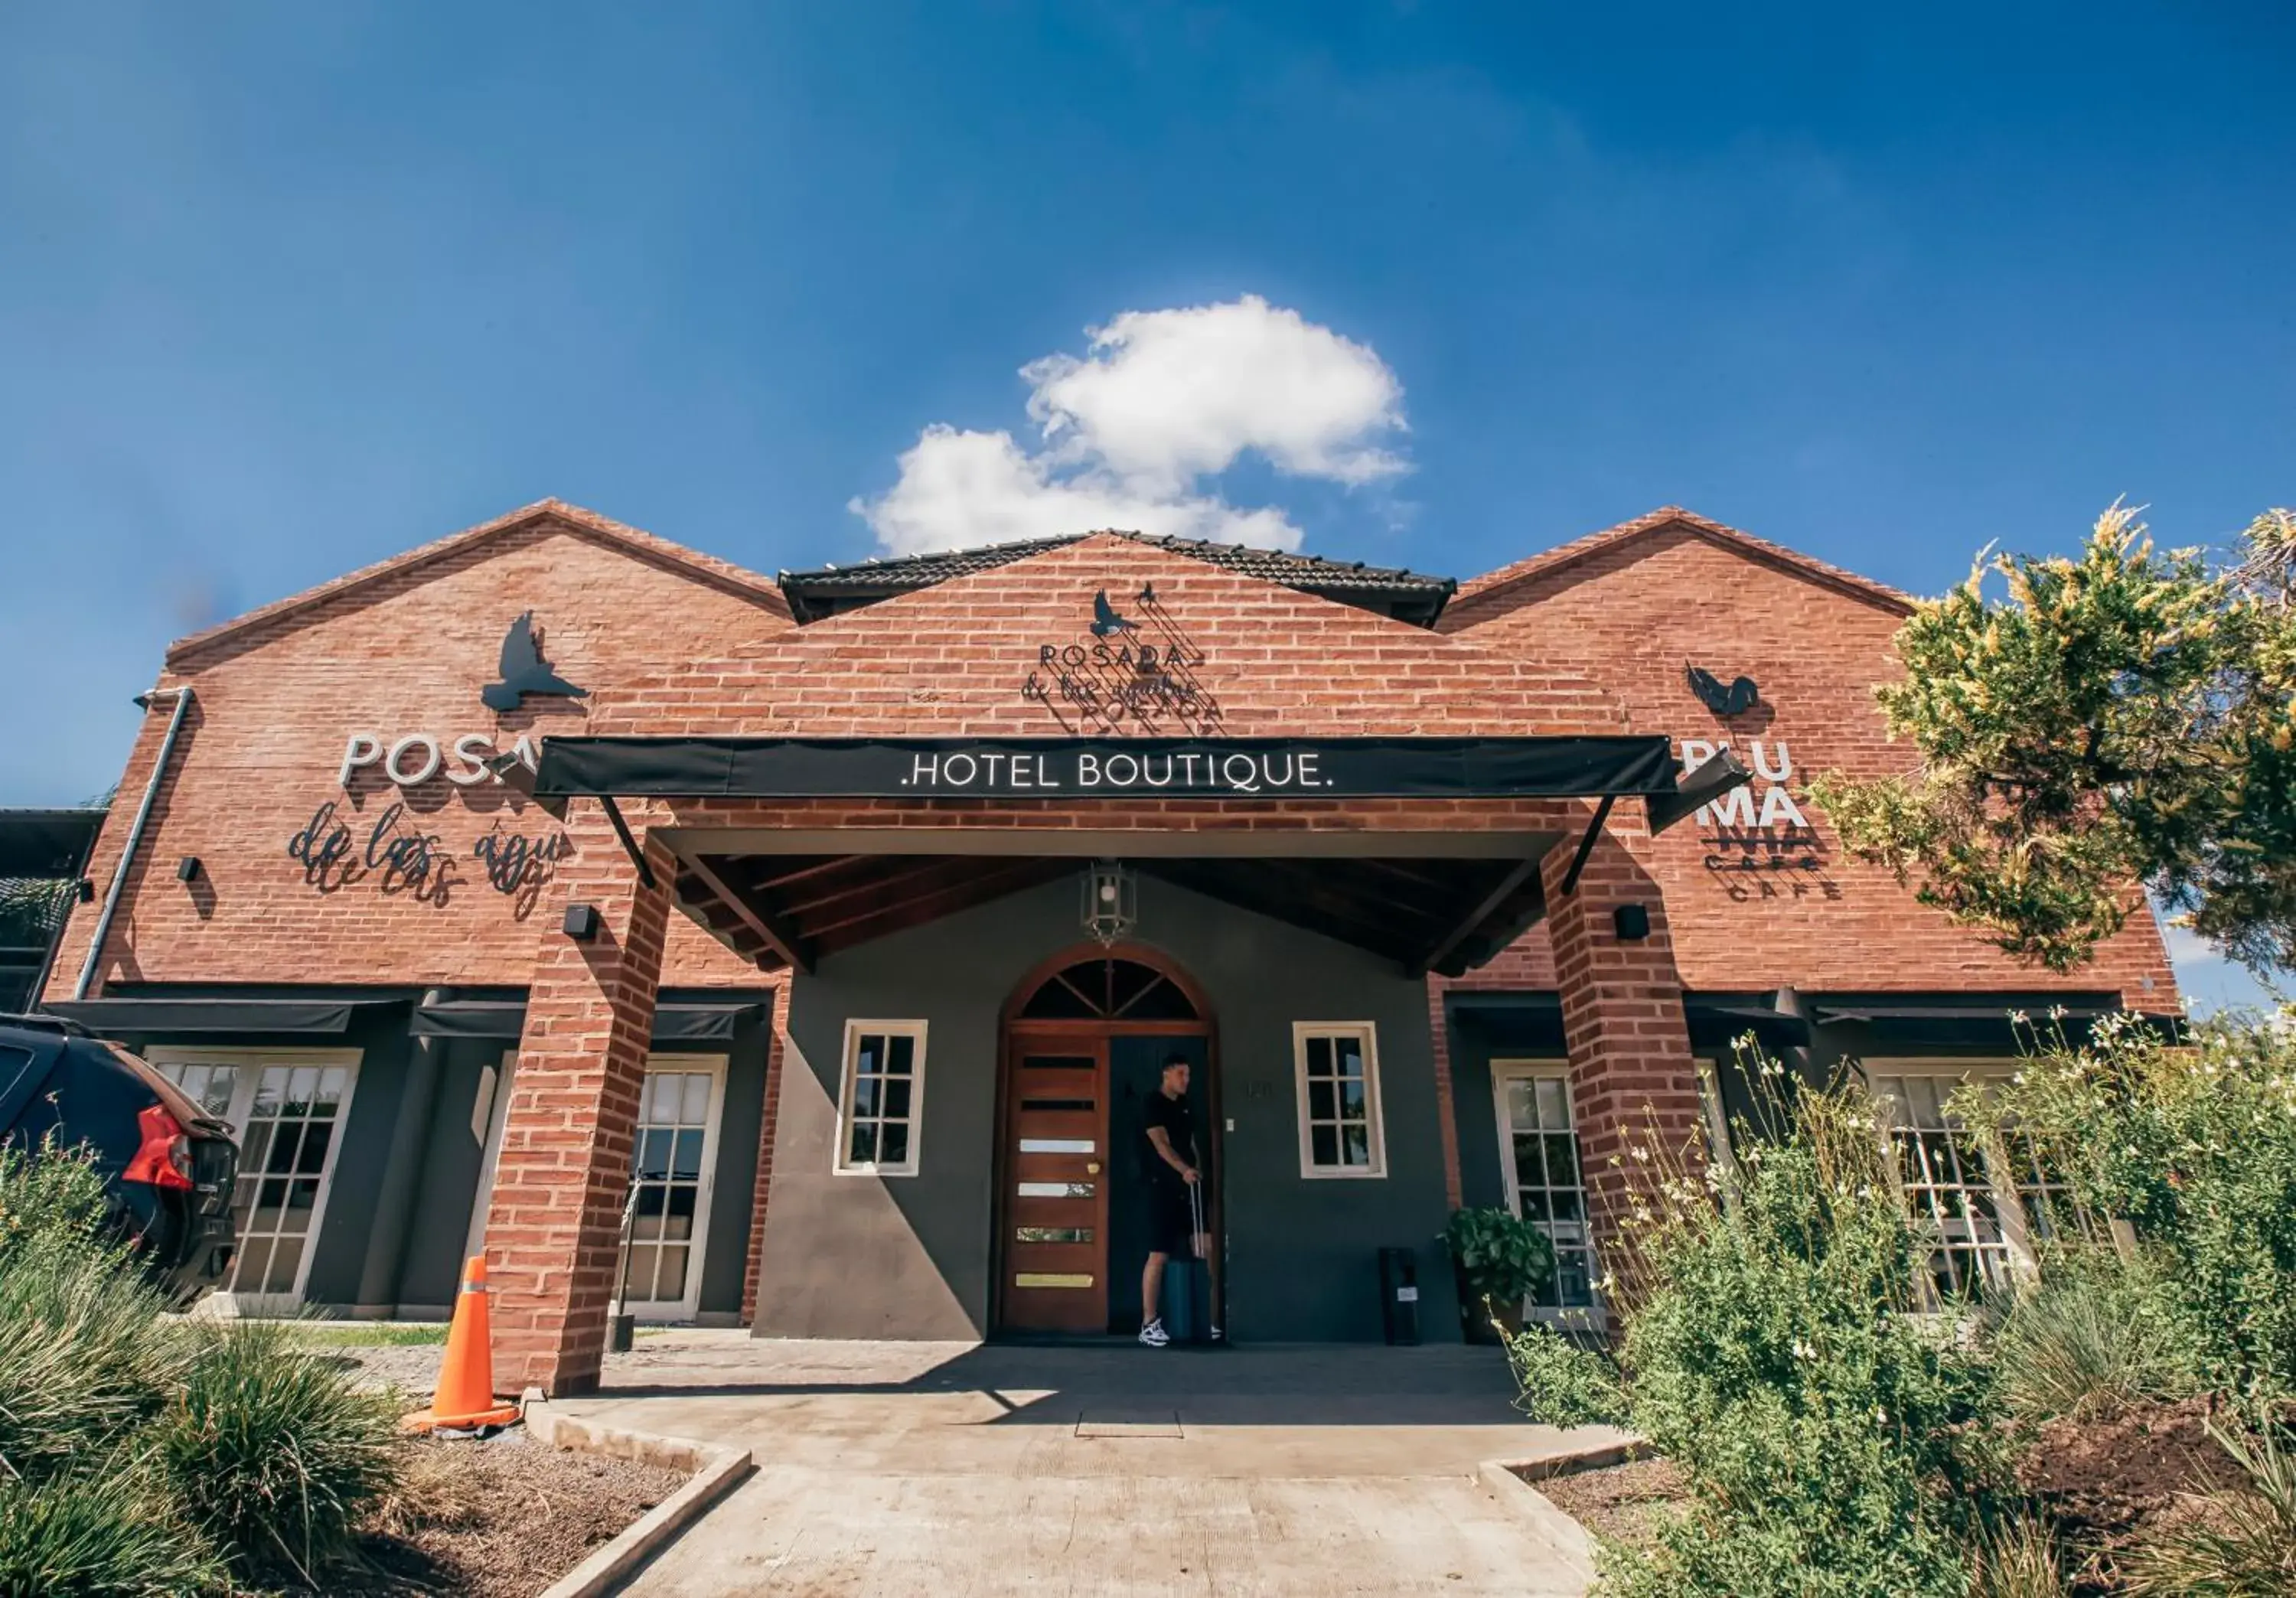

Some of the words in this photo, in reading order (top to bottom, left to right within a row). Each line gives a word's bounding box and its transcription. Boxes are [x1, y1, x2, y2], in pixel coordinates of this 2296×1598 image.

[1040, 644, 1183, 667] POSADA
[1078, 754, 1334, 791] BOUTIQUE.
[1680, 739, 1792, 781] PU
[1696, 785, 1809, 827] MA
[289, 802, 352, 869] de
